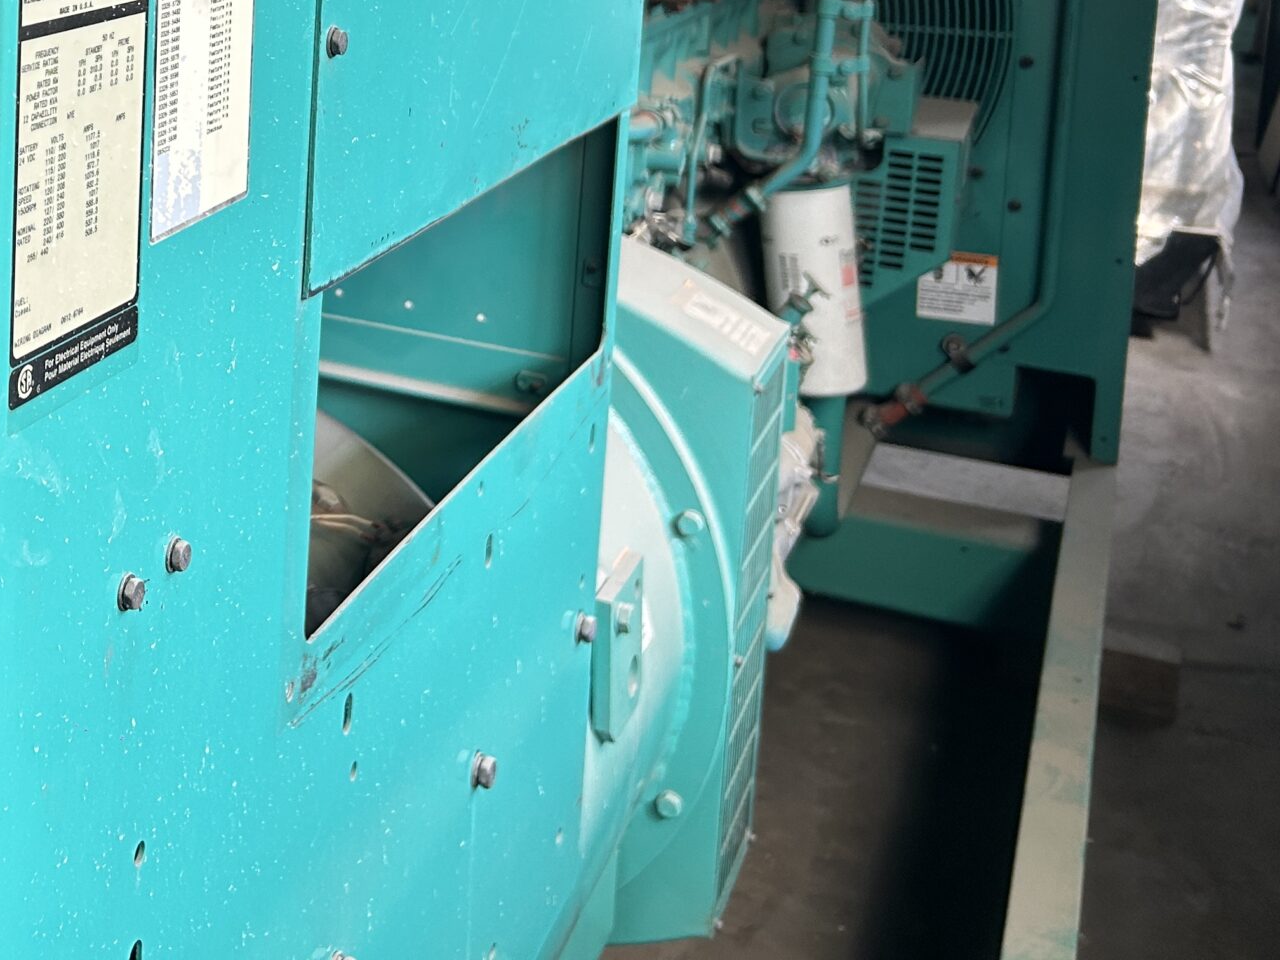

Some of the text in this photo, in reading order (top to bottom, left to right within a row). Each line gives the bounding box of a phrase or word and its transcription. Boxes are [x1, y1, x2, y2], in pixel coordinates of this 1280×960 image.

[60, 6, 69, 14] MADE
[45, 324, 118, 369] For Electrical Equipment Only
[45, 370, 57, 381] Pour
